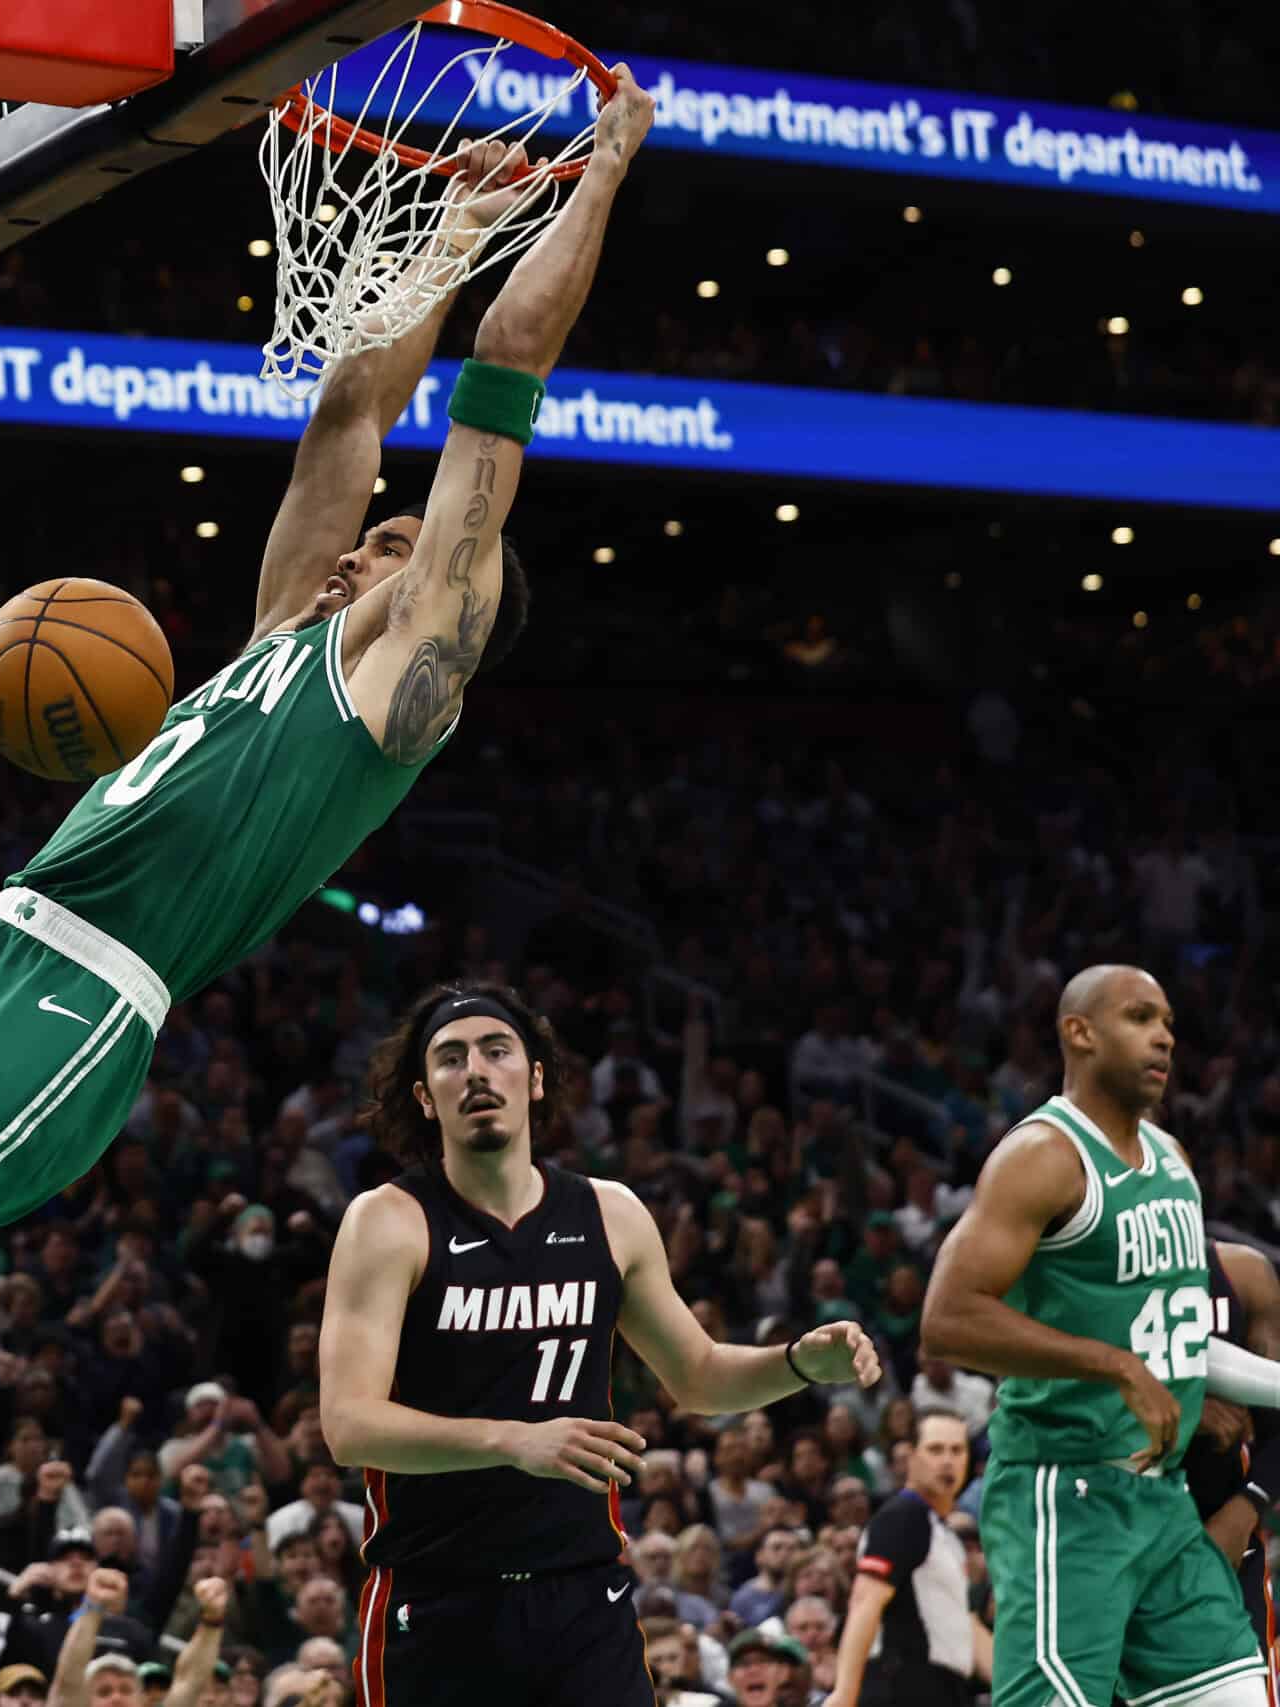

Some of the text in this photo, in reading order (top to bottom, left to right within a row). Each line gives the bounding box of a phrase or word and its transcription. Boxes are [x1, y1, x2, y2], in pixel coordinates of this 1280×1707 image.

[464, 56, 576, 118] Your
[646, 71, 946, 158] department's
[951, 108, 996, 162] IT
[1004, 112, 1262, 192] department.
[50, 346, 324, 421] departmen
[397, 377, 440, 428] T
[538, 388, 733, 450] artment.
[104, 715, 206, 807] 0
[1116, 1198, 1208, 1284] BOSTON
[437, 1281, 597, 1331] MIAMI
[1129, 1286, 1212, 1381] 42
[530, 1338, 588, 1402] 11
